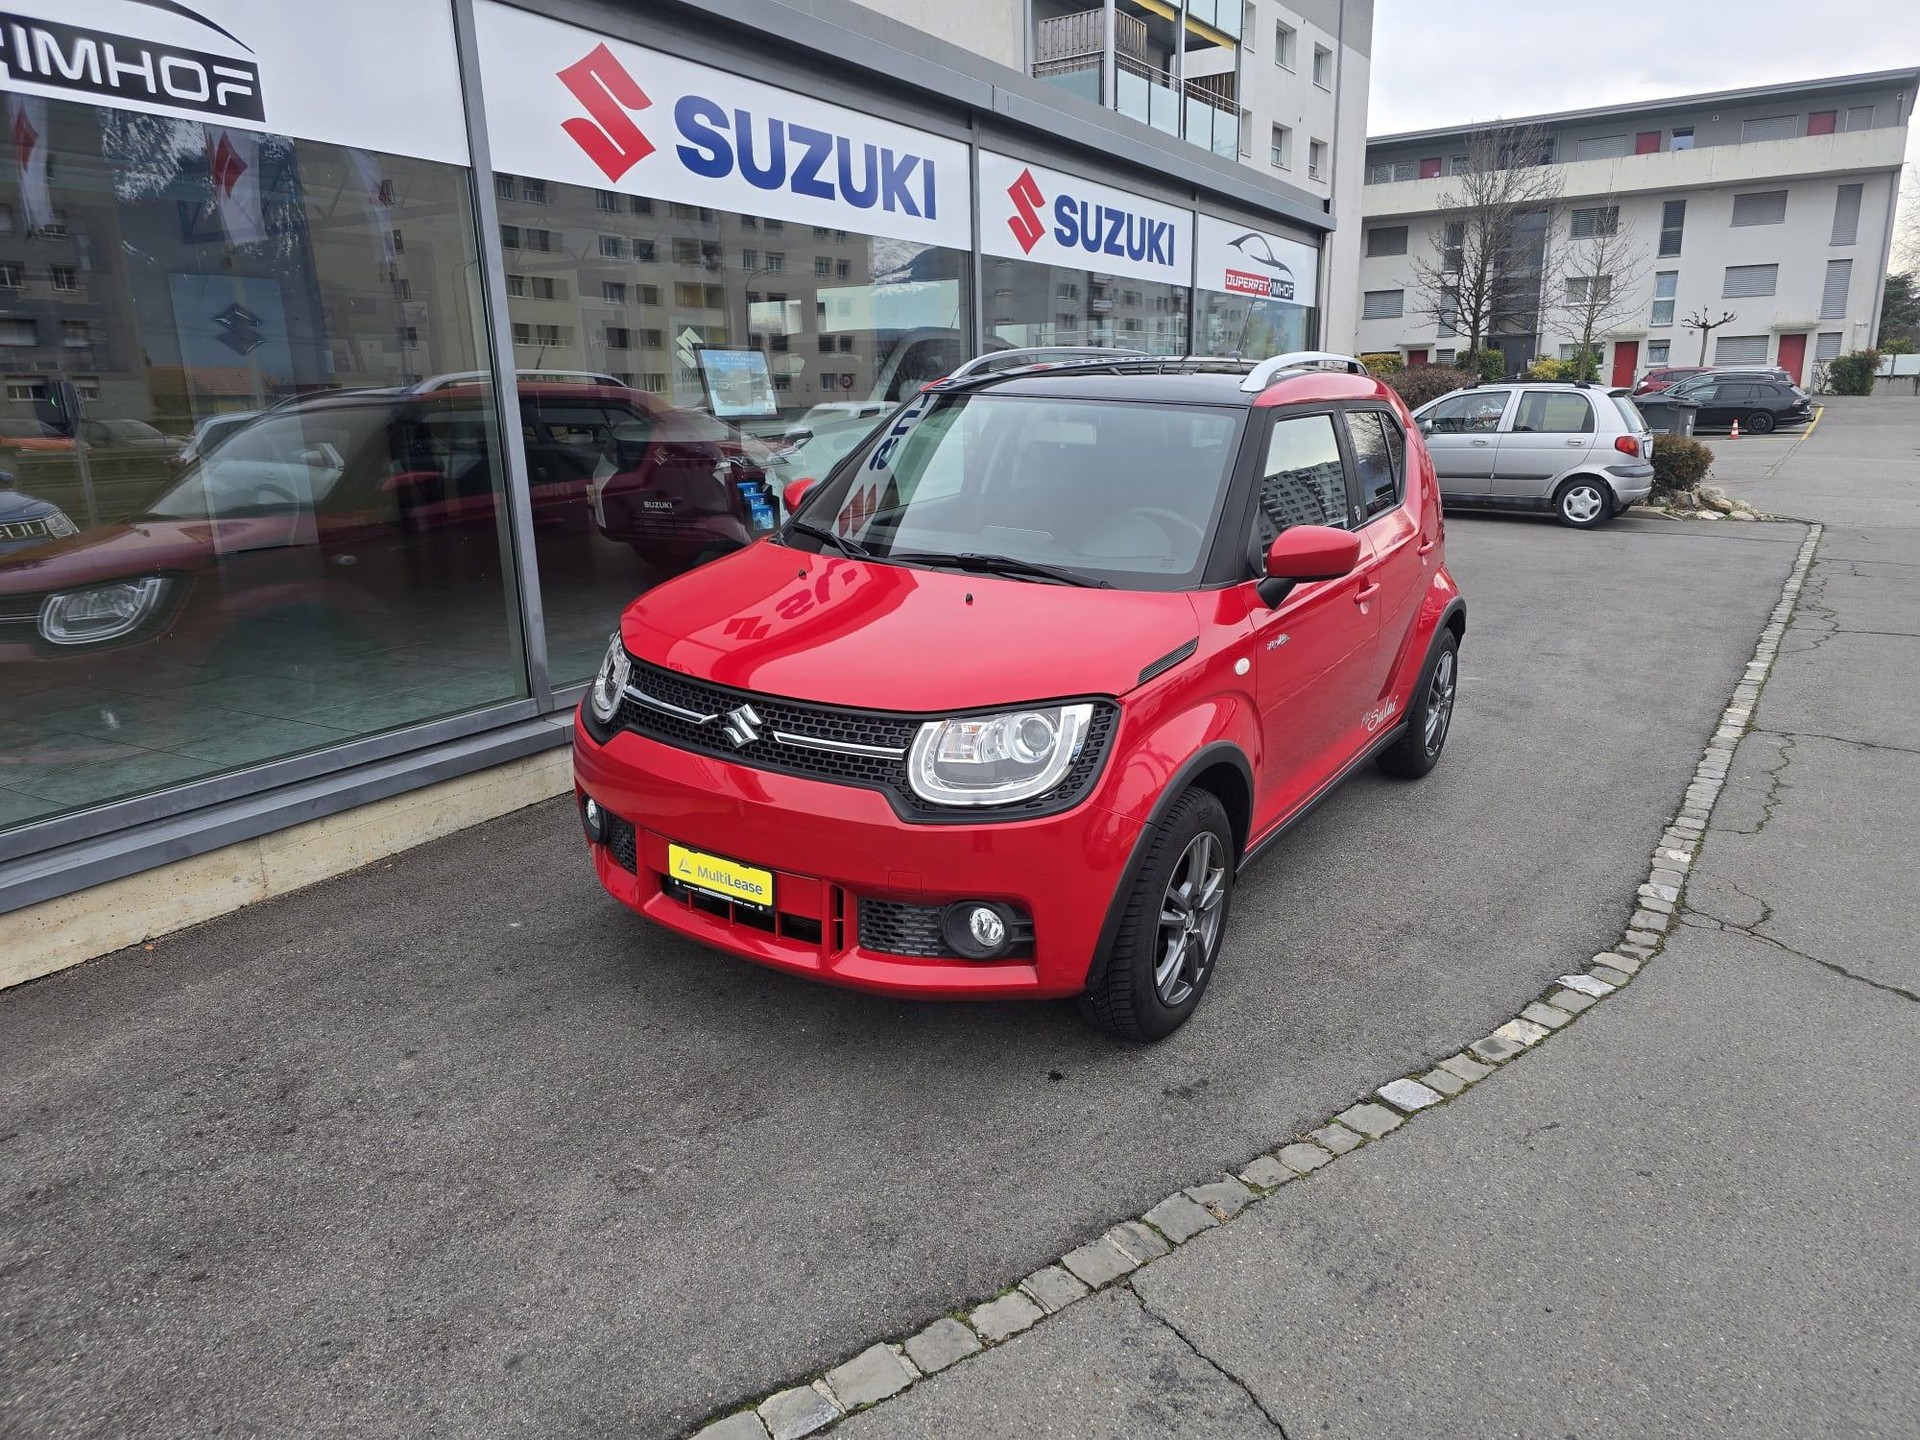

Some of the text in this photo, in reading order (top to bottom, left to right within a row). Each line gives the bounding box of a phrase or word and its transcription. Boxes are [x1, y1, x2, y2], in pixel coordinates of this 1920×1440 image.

[10, 23, 255, 107] IMHOF
[674, 94, 936, 220] SUZUKI
[1053, 194, 1175, 267] SUZUKI
[1226, 273, 1269, 292] DUPERRET
[643, 501, 673, 509] SUZUKI
[697, 865, 763, 895] MultiLease
